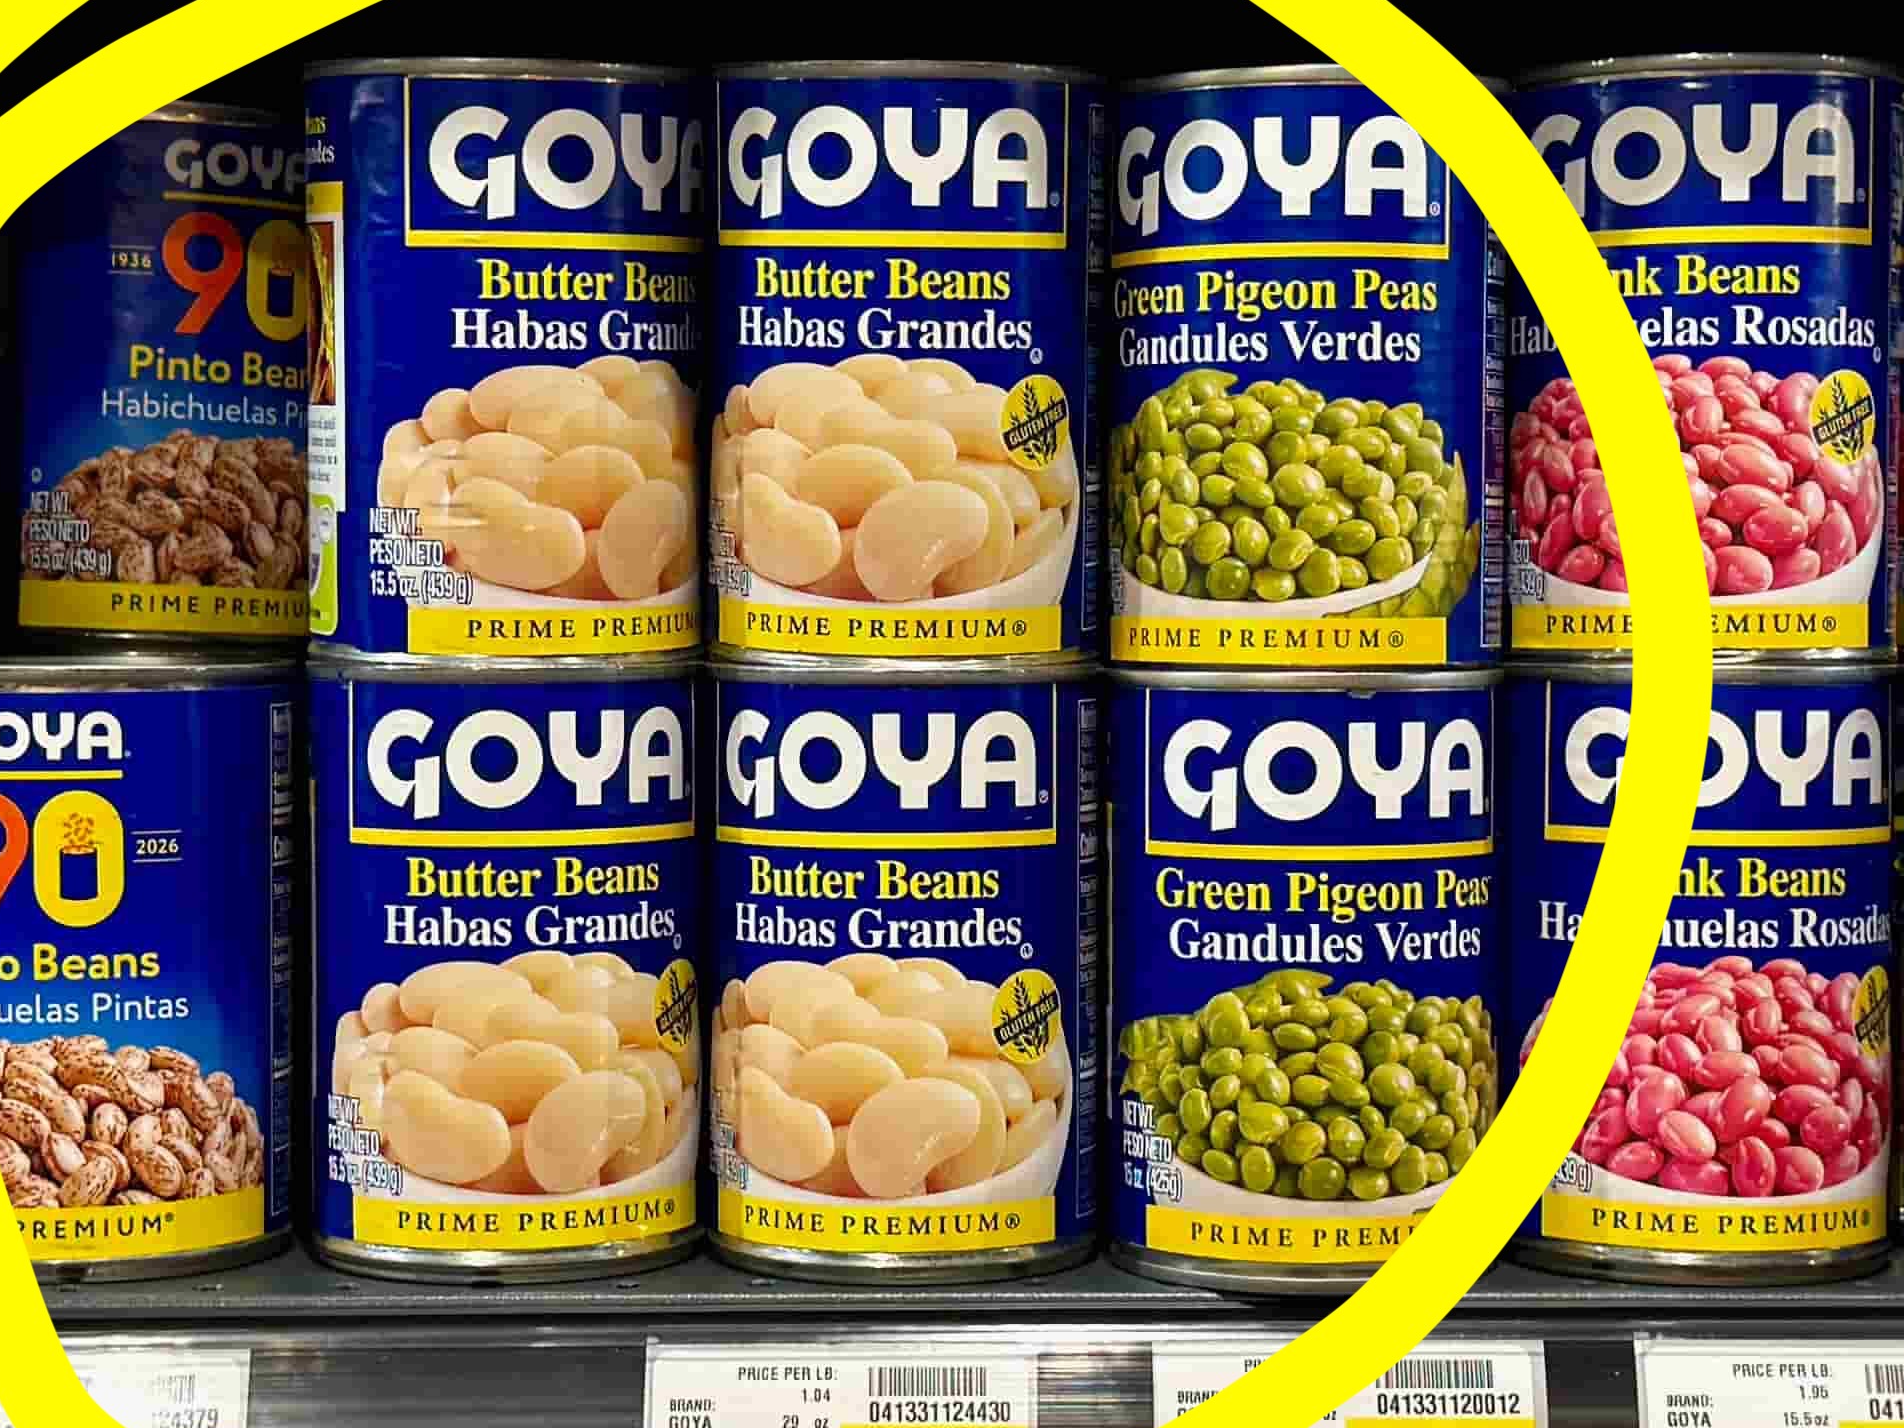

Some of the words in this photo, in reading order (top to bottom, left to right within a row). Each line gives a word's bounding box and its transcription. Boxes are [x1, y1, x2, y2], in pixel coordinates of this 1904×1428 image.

[729, 106, 1049, 220] GOYA
[753, 258, 875, 300] Butter
[884, 258, 1011, 301] Beans
[1115, 271, 1187, 319] Green
[1196, 268, 1338, 322] Pigeon
[1350, 270, 1439, 315] Peas
[737, 306, 846, 348] Habas
[857, 309, 1034, 351] Grandes
[1119, 321, 1274, 367] Gandules
[1284, 321, 1422, 363] Verdes
[136, 838, 181, 856] 2026
[406, 858, 544, 901] Butter
[553, 859, 661, 897] Beans
[868, 1401, 1011, 1423] 041331124430
[1377, 1393, 1521, 1416] 041331120012
